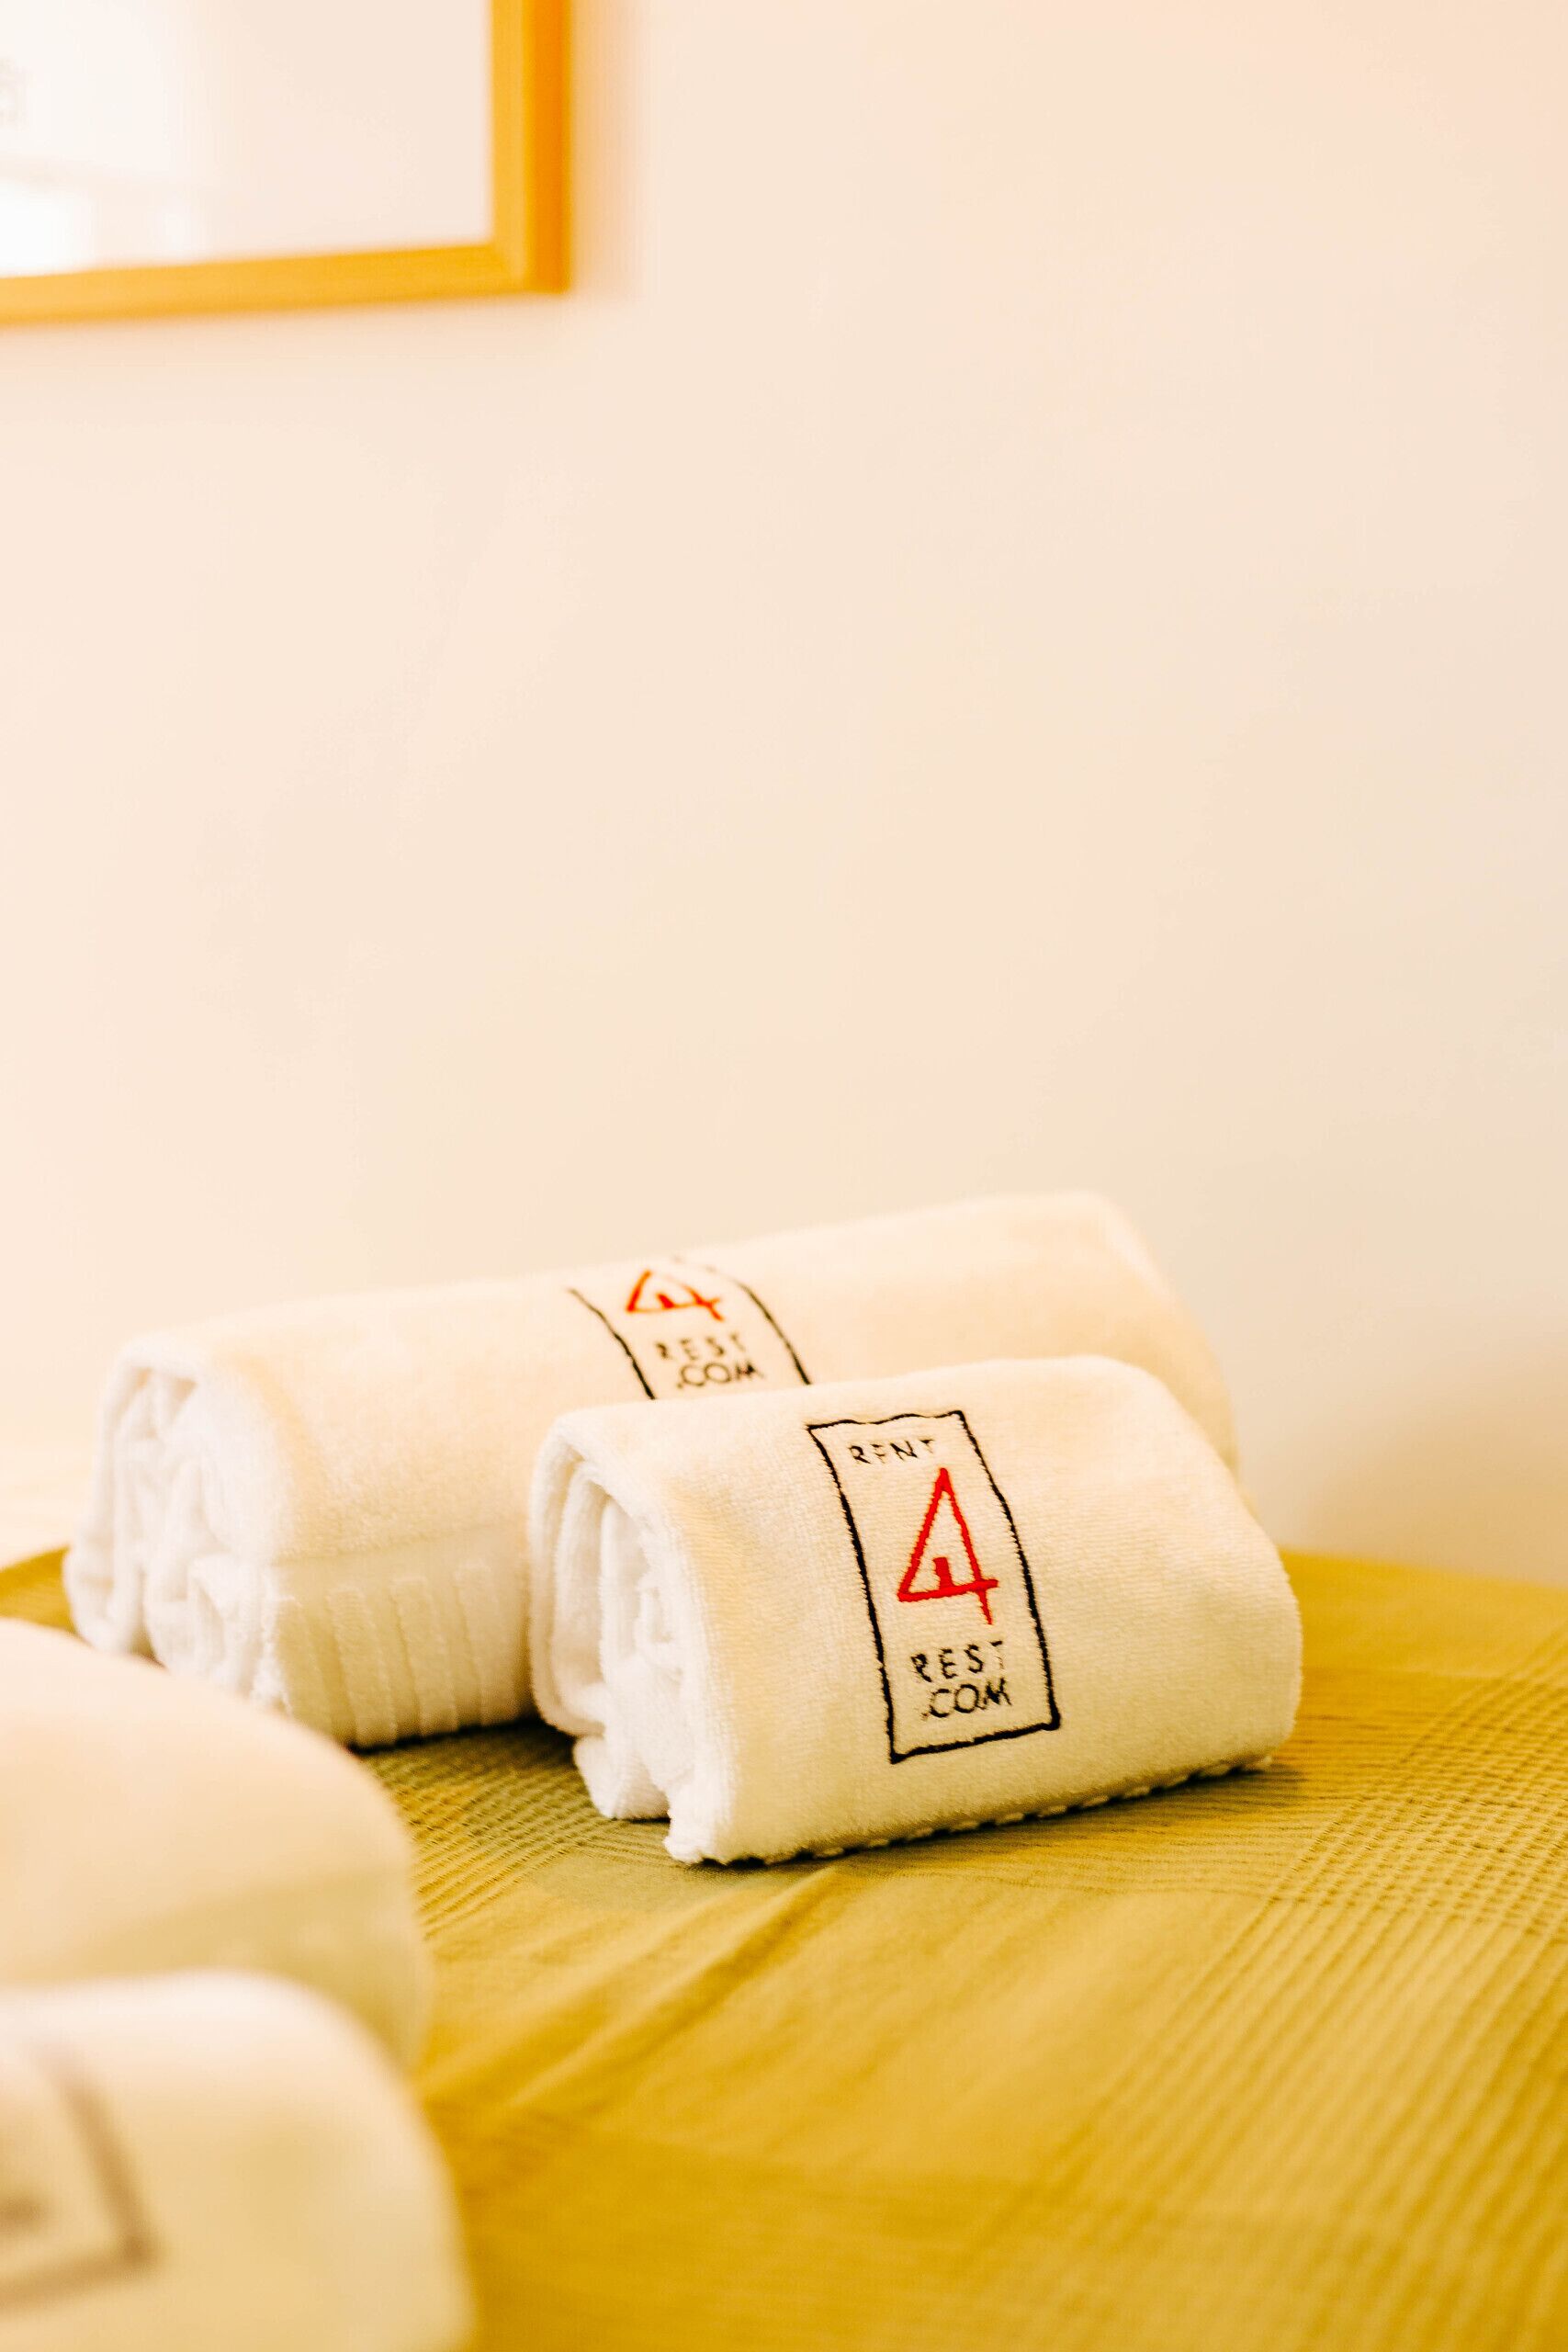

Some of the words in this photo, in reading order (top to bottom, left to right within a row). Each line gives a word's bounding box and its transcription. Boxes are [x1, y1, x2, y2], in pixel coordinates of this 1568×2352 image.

[626, 1269, 724, 1322] 4
[847, 1437, 935, 1465] RENT
[897, 1467, 998, 1625] 4
[909, 1639, 1003, 1683] REST
[920, 1677, 1012, 1720] .COM
